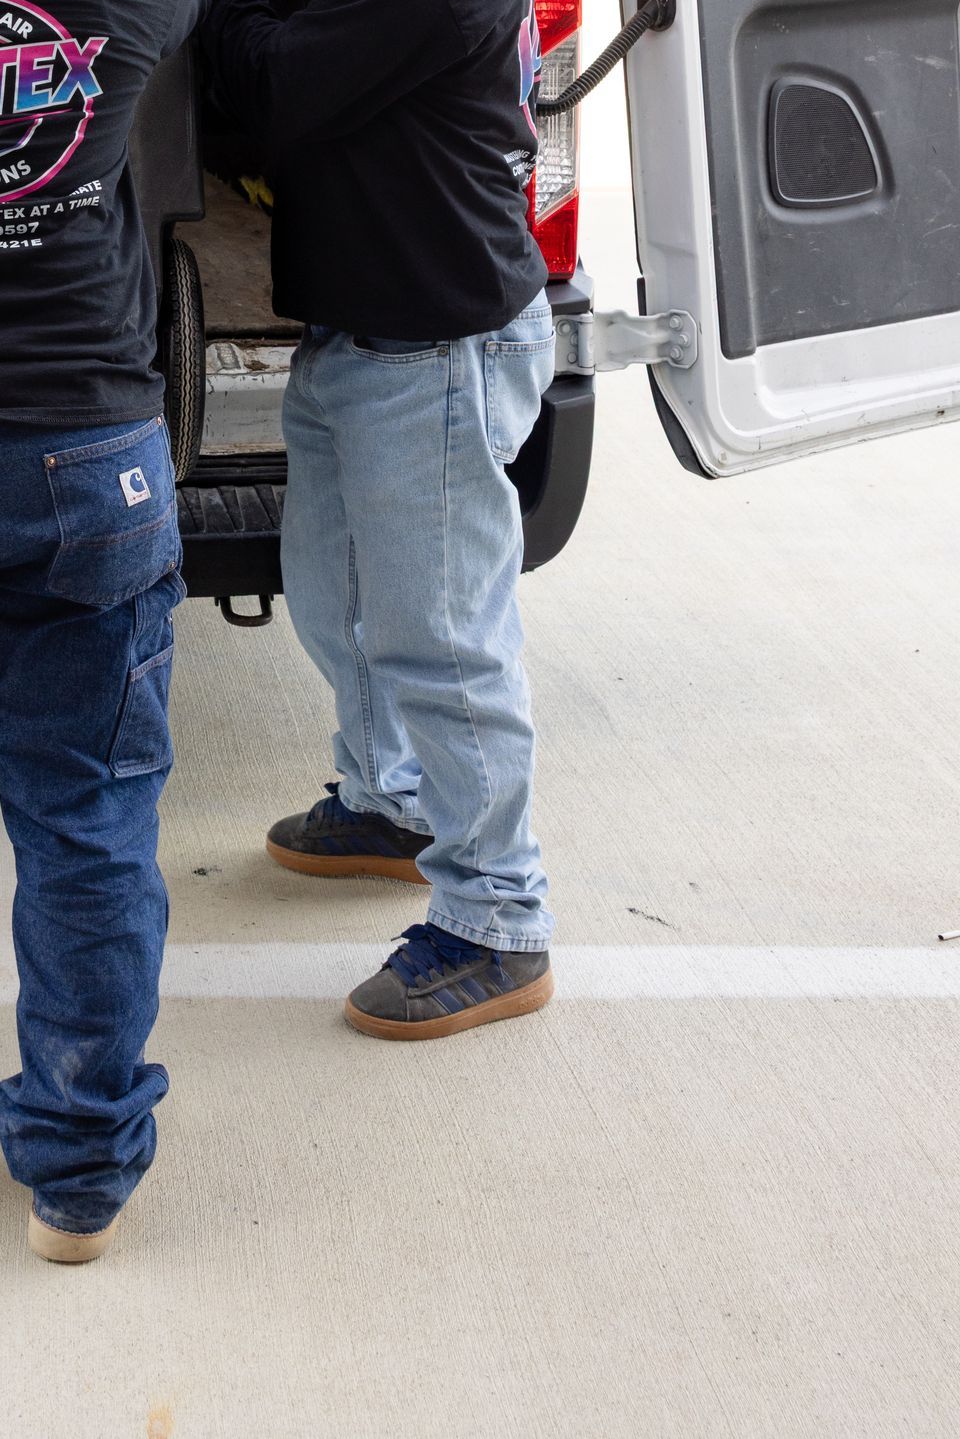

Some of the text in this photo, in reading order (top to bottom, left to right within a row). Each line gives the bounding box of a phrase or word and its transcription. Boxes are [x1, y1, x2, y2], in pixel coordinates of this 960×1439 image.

[30, 204, 51, 217] AT
[53, 202, 65, 214] A
[68, 195, 100, 211] TIME
